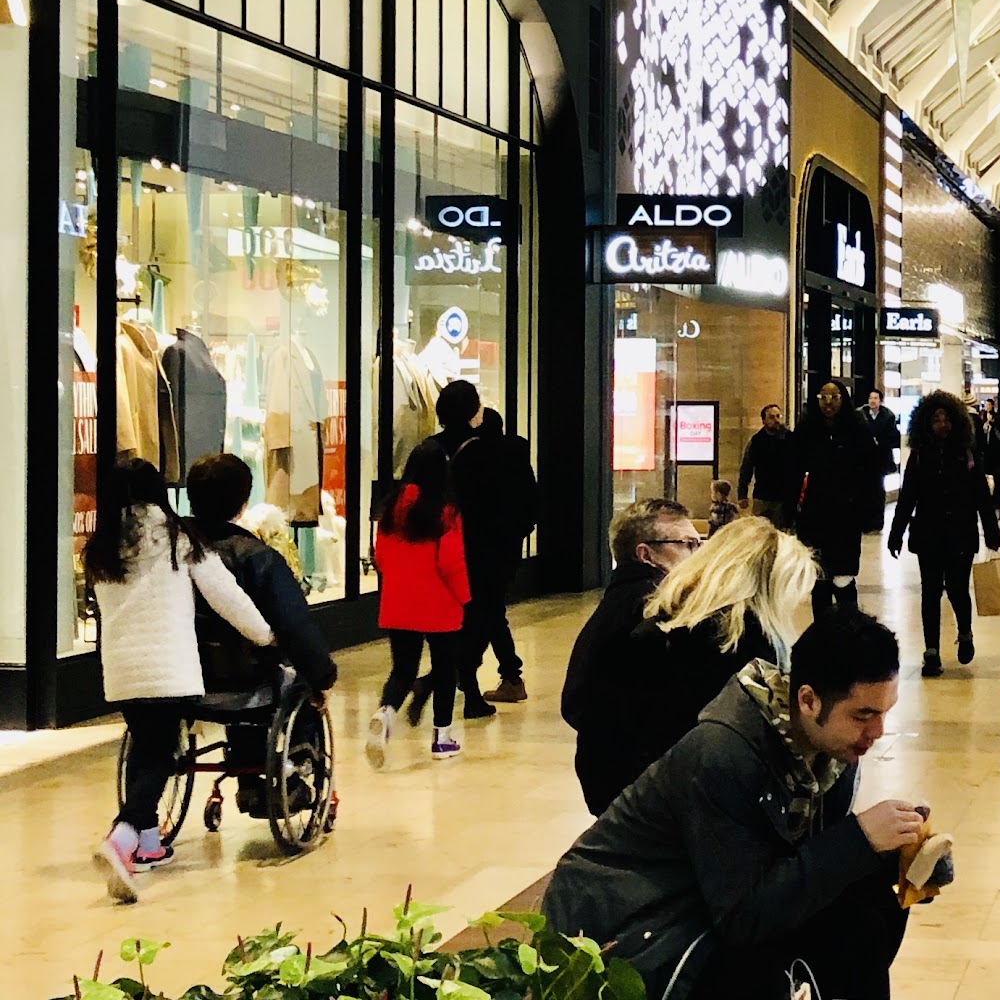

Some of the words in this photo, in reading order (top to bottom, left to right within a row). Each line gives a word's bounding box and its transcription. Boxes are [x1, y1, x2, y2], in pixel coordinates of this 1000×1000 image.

[628, 204, 732, 227] ALDO
[886, 312, 933, 331] Earls
[680, 421, 712, 432] Boxing
